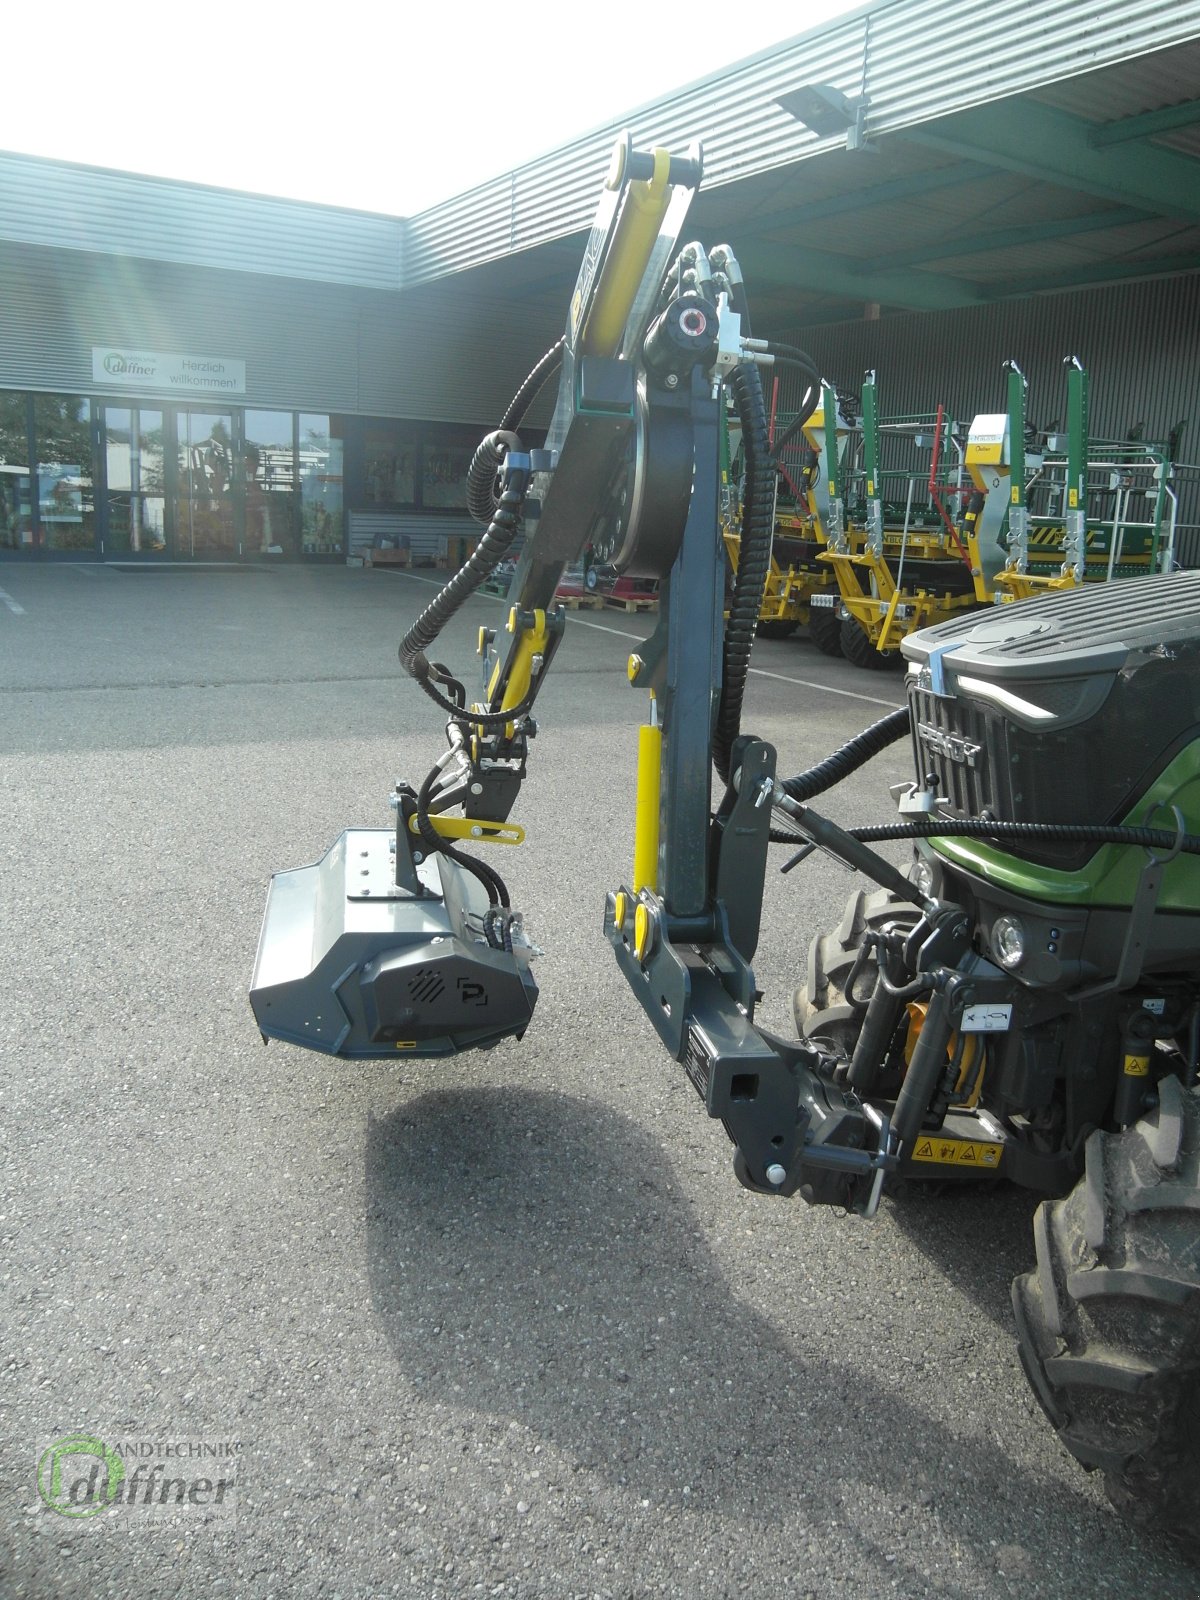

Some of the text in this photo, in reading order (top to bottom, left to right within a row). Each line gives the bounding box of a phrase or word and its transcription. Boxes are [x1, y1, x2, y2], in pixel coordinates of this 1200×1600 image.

[182, 359, 225, 374] Herzlich
[169, 373, 237, 388] willkommen!
[917, 722, 981, 767] FENDT
